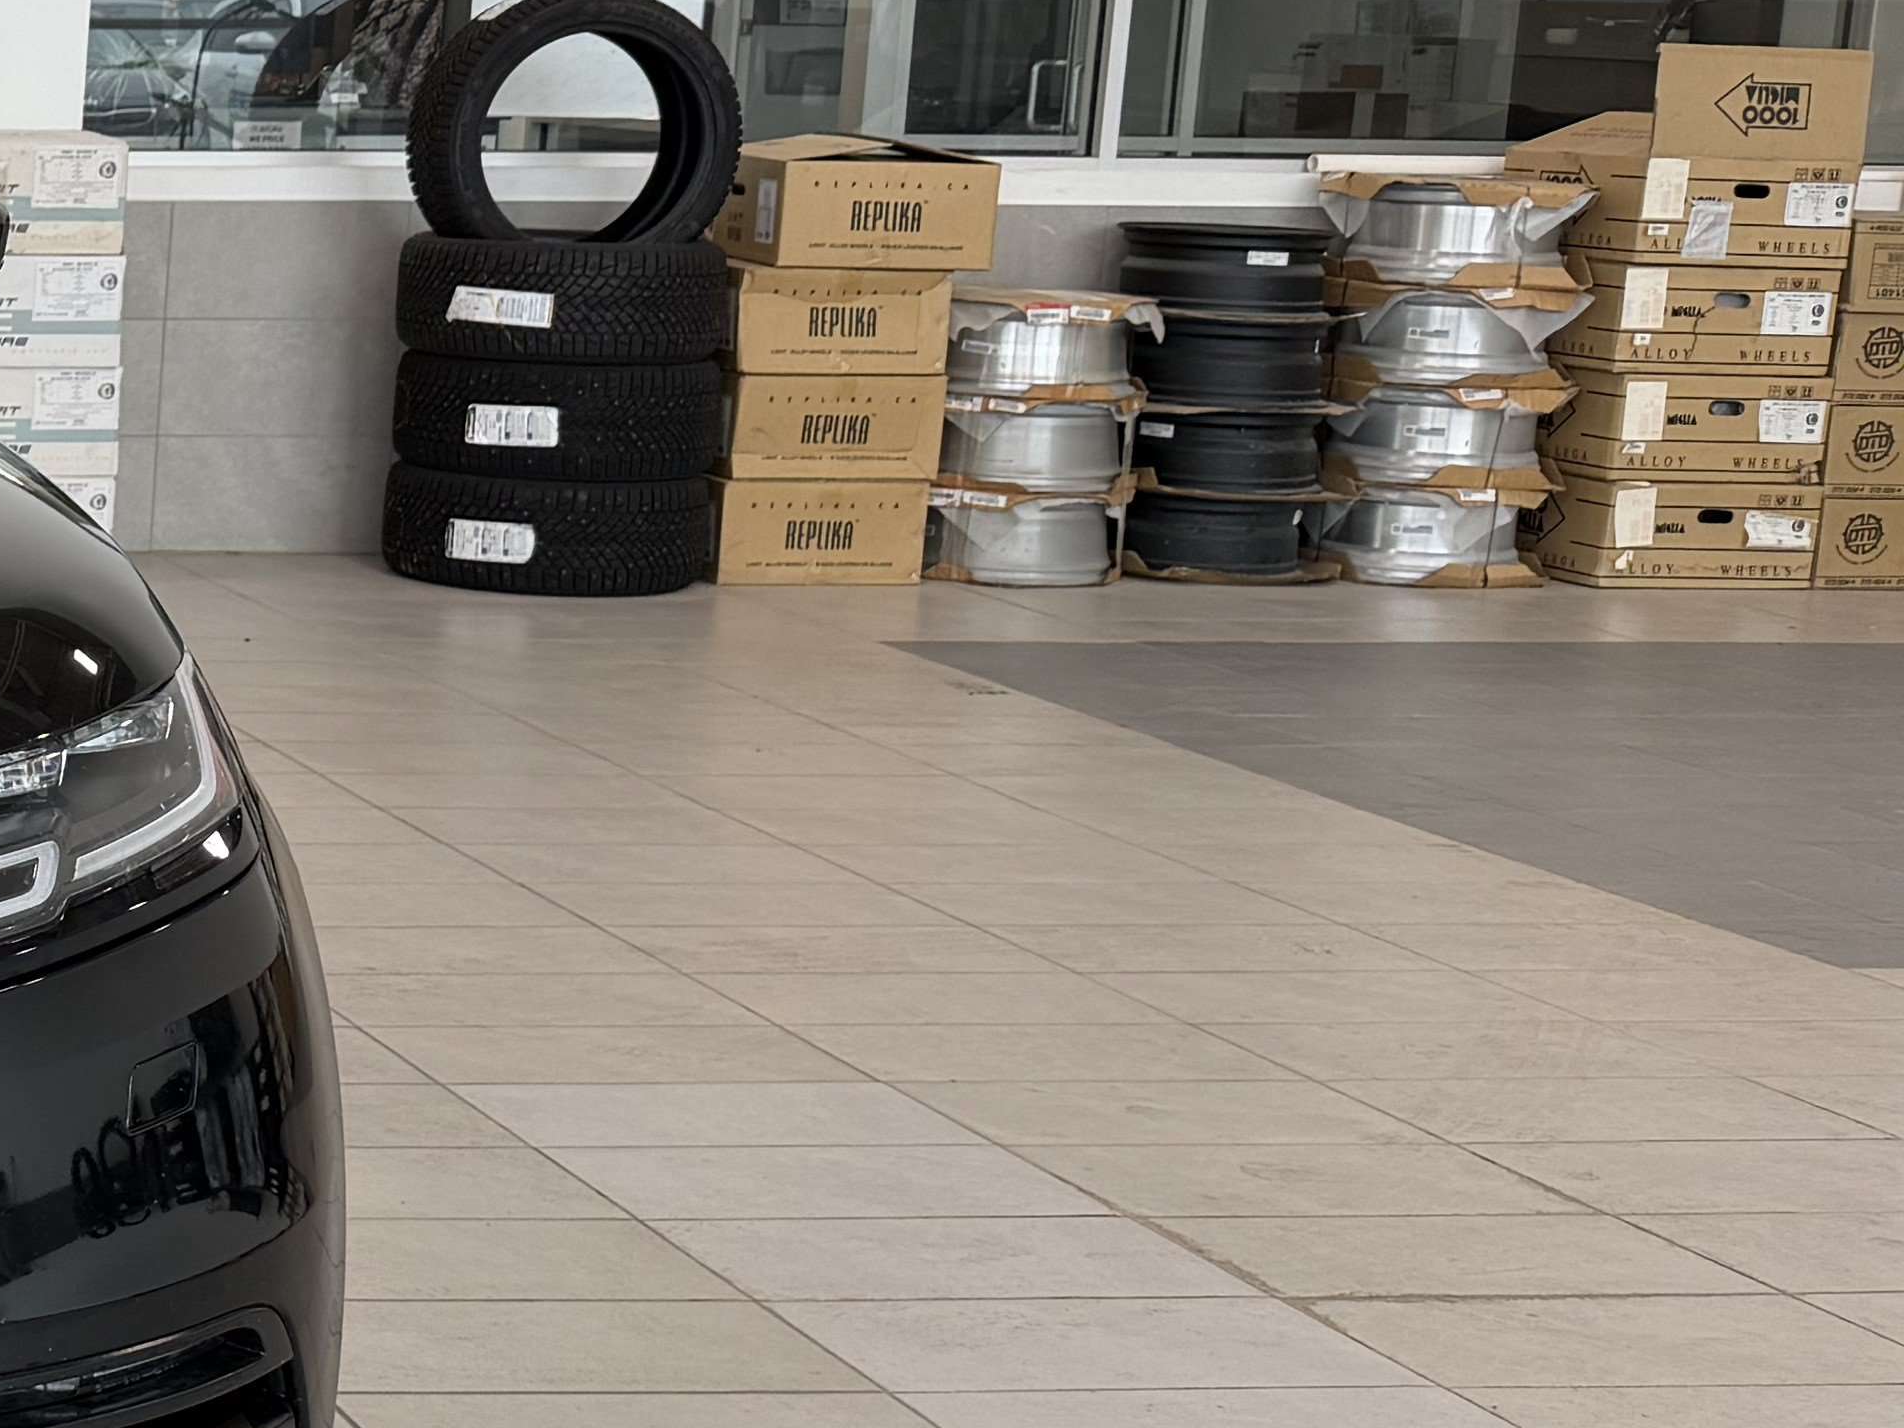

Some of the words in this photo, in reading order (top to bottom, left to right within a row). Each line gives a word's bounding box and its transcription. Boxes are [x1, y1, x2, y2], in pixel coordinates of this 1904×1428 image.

[1745, 85, 1801, 105] MIGLIA
[1743, 105, 1800, 126] 1000
[850, 200, 923, 233] REPLIKA
[1650, 238, 1682, 250] ALL
[1757, 241, 1832, 253] WHEELS
[808, 306, 878, 338] REPLIKA
[1631, 348, 1693, 360] ALLOY
[1740, 350, 1812, 362] WHEELS
[800, 414, 871, 445] REPLIKA
[1626, 456, 1687, 468] ALLOY
[1733, 457, 1804, 470] WHEELS
[784, 519, 855, 551] REPLIKA
[1615, 563, 1675, 575] LLOY
[1720, 565, 1793, 577] WHEELS
